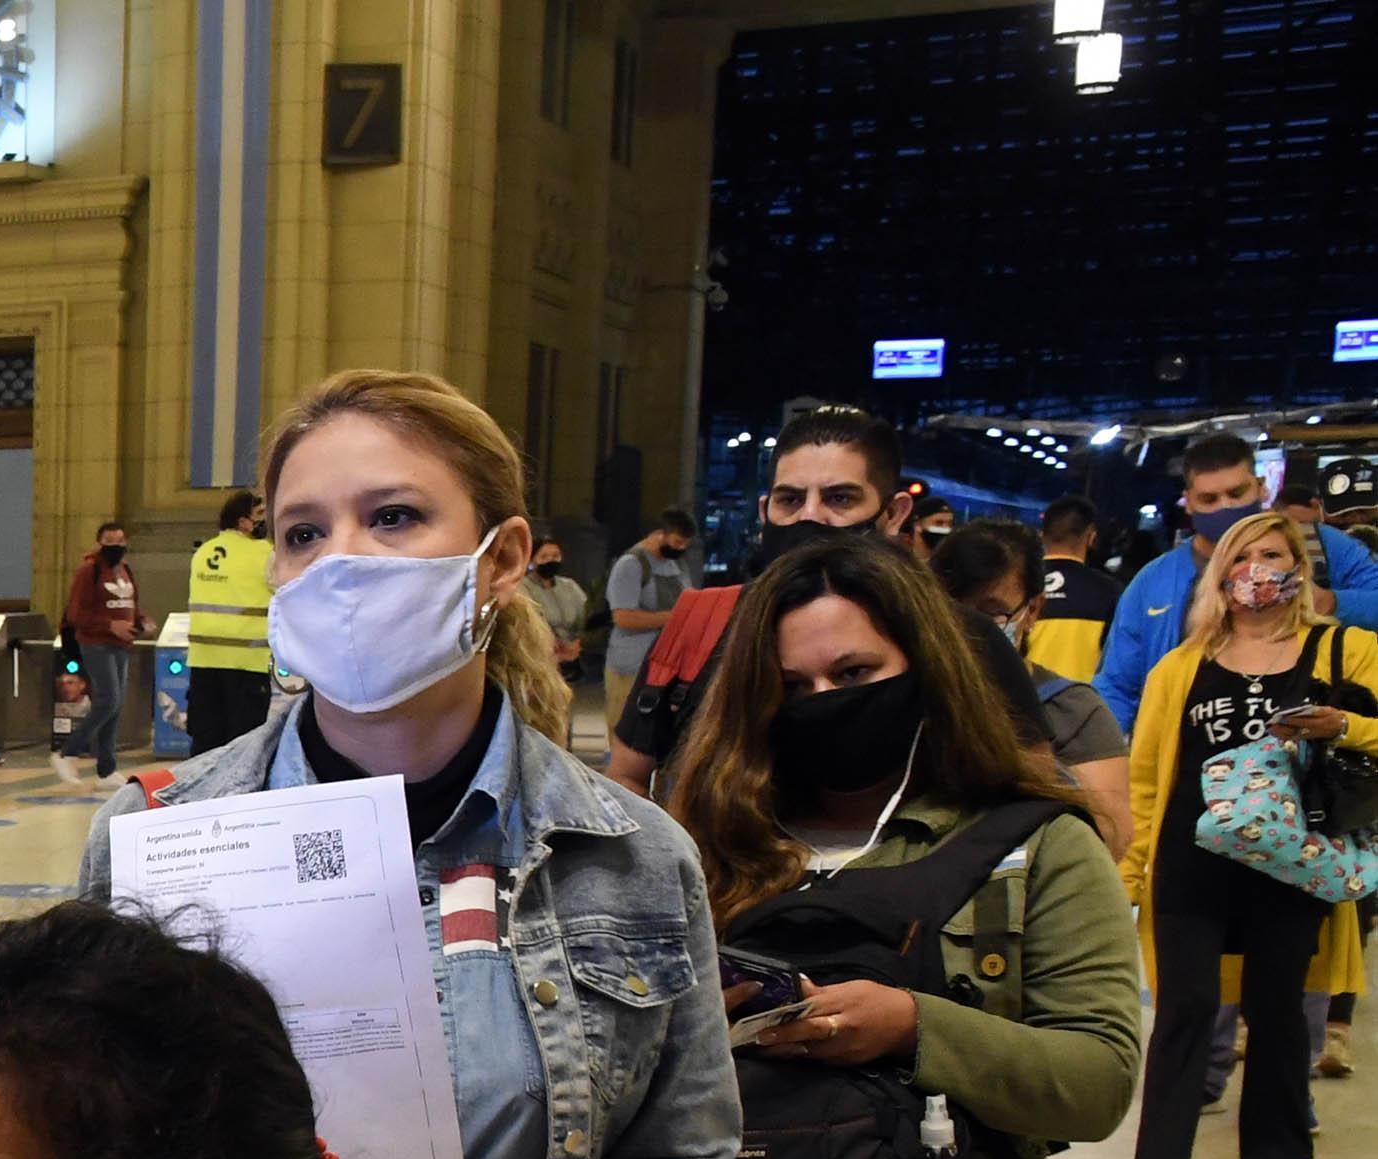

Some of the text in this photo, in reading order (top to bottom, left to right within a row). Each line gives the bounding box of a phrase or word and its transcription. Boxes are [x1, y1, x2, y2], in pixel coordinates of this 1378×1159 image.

[340, 78, 384, 149] 7
[1189, 697, 1235, 727] THE
[1204, 718, 1233, 744] IS
[146, 828, 203, 845] Argentina unida
[146, 840, 251, 863] Actividades esenciales
